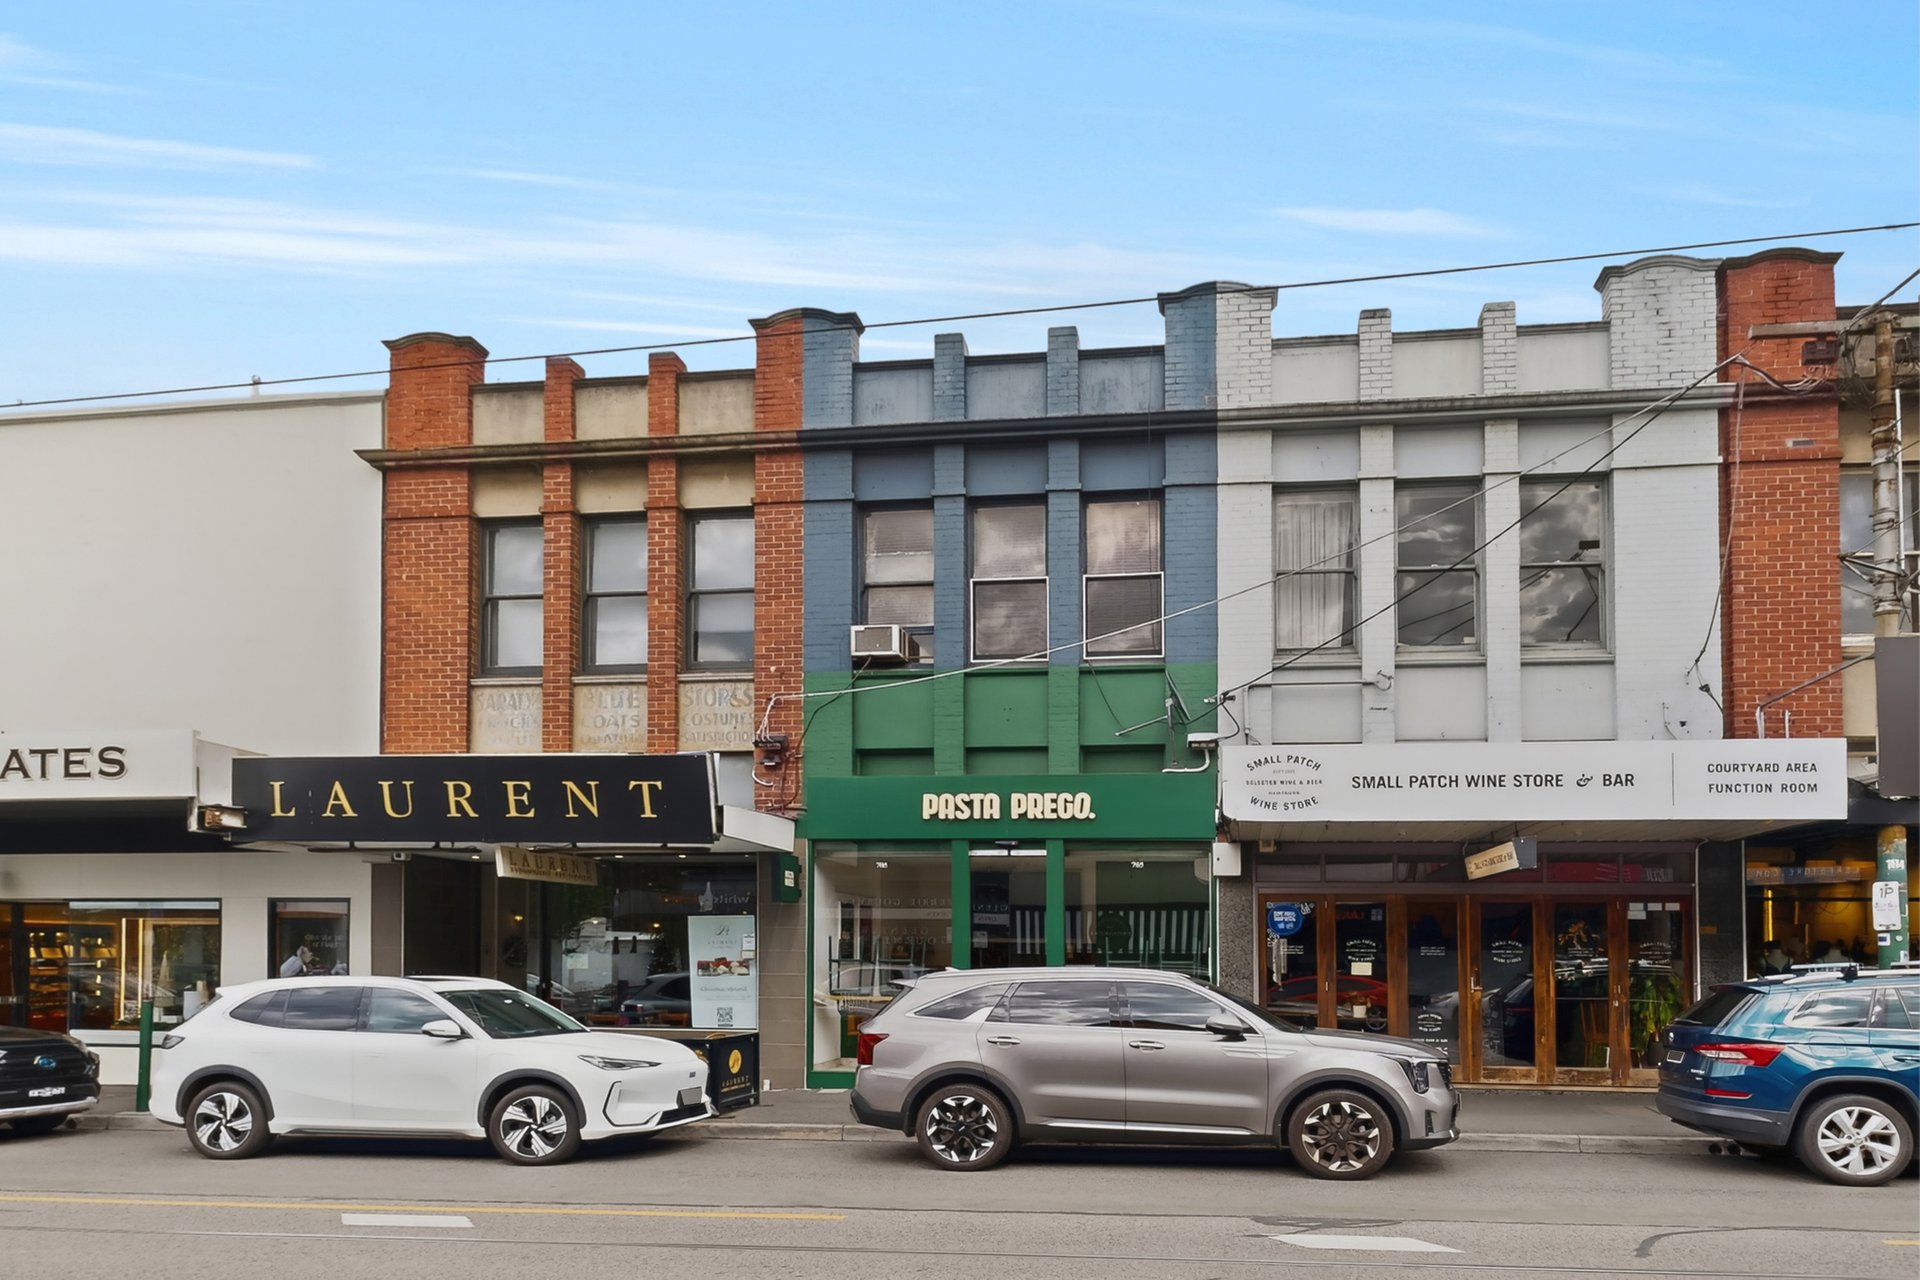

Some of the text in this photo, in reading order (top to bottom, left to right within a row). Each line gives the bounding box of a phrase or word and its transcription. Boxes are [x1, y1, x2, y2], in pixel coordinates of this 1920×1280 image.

[0, 747, 127, 780] ATES
[1246, 755, 1322, 772] SMALL PATCH
[1707, 763, 1818, 773] COURTYARD AREA
[1351, 773, 1635, 789] SMALL PATCH WINE STORE & BAR
[1708, 783, 1818, 793] FUNCTION ROOM
[269, 780, 663, 818] LAURENT
[922, 792, 1097, 820] PASTA PREGO.
[1250, 796, 1319, 811] WINE STORE
[508, 850, 592, 875] LAURENT
[1880, 887, 1894, 898] 1P
